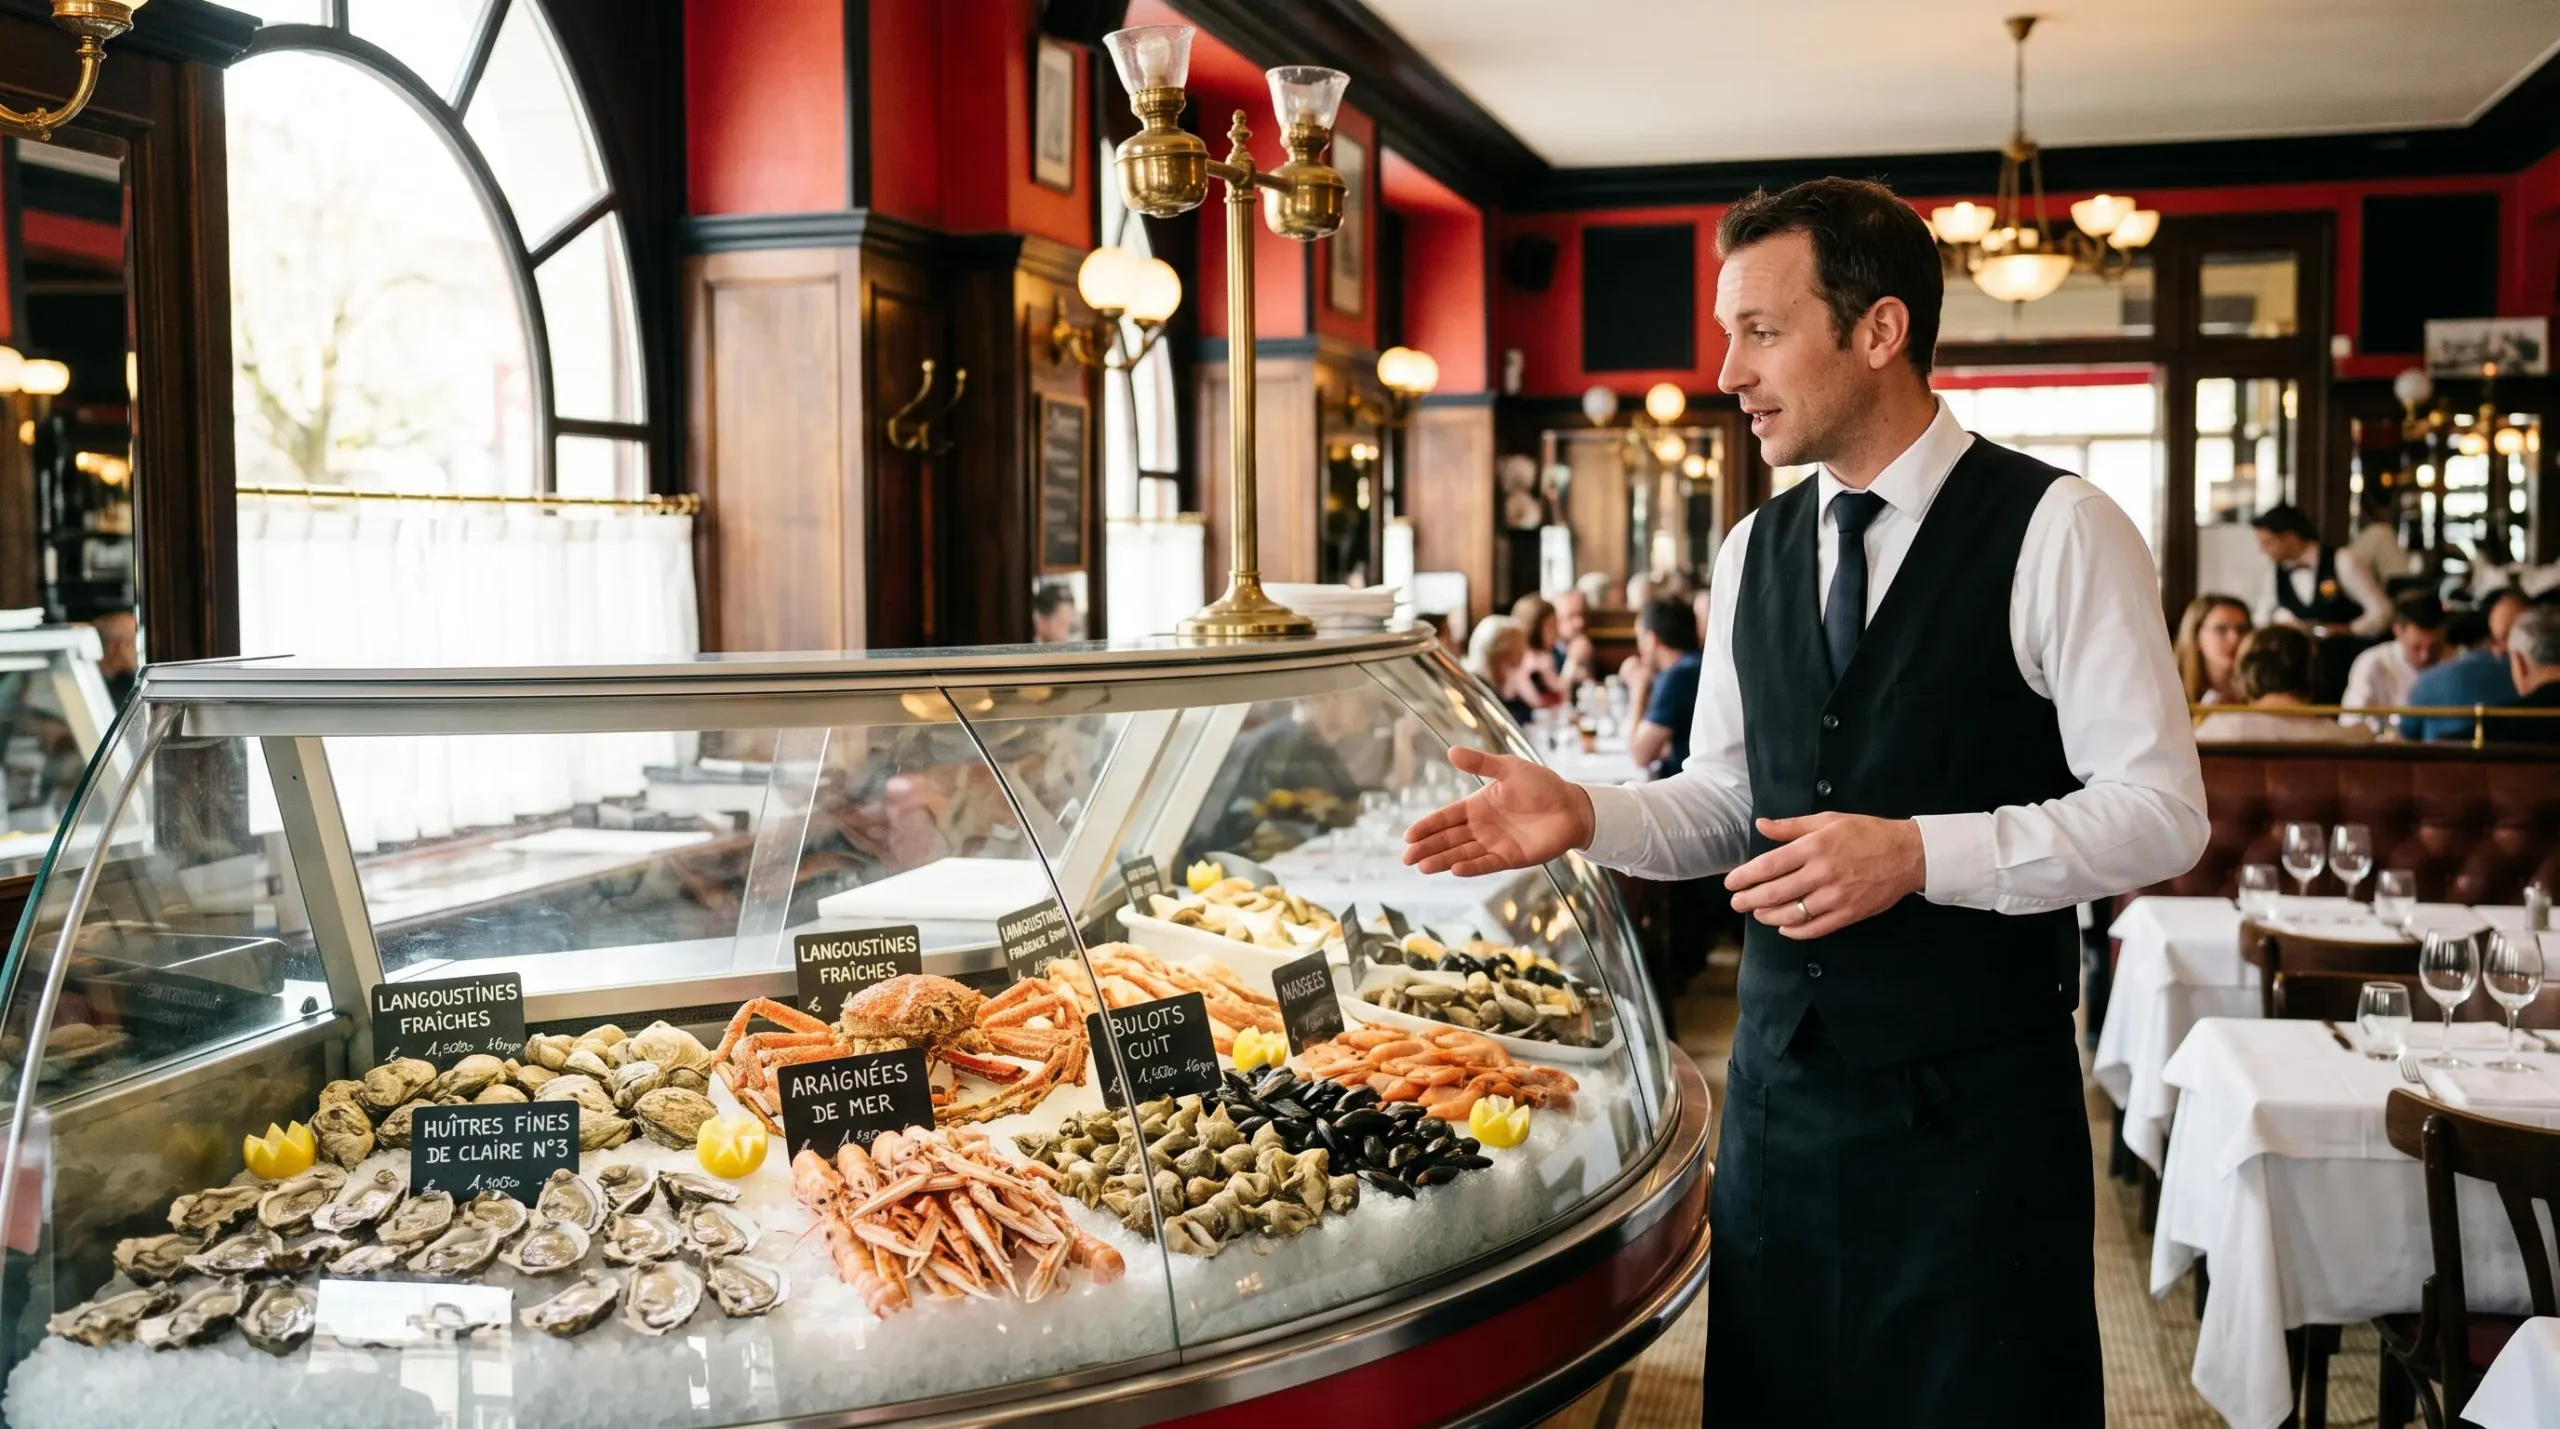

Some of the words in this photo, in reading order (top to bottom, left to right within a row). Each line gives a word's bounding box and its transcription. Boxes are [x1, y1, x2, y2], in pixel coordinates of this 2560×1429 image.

[800, 933, 917, 963] LANGOUSTINES
[820, 960, 898, 984] FRAÎCHES
[378, 981, 518, 1012] LANGOUSTINES
[400, 1010, 491, 1035] FRAÎCHES
[1111, 1005, 1185, 1038] BULOTS
[1128, 1032, 1171, 1060] CUIT
[791, 1059, 908, 1099] ARAIGNÉES
[812, 1102, 839, 1124] DE
[849, 1094, 895, 1117] MER
[424, 1113, 504, 1139] HUÎTRES
[515, 1110, 570, 1134] FINES
[426, 1146, 451, 1164] DE
[458, 1139, 523, 1162] CLAIRE
[532, 1139, 569, 1159] N°3
